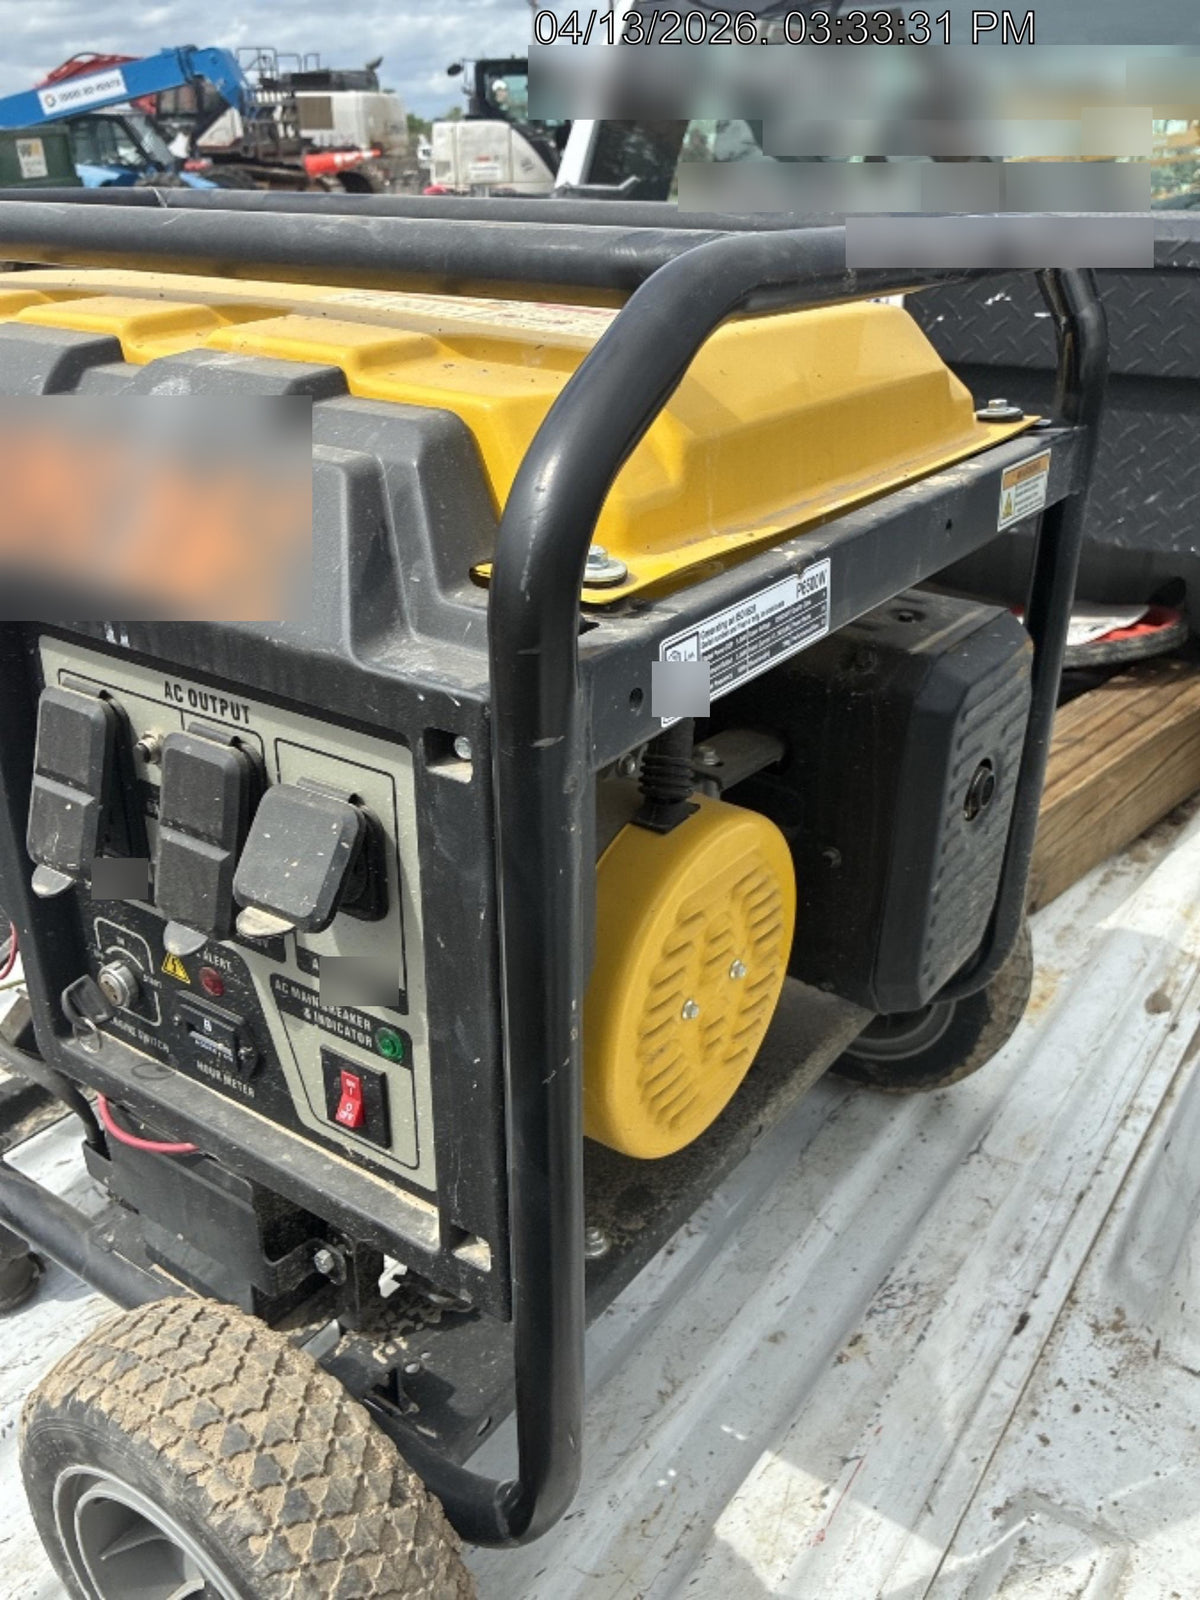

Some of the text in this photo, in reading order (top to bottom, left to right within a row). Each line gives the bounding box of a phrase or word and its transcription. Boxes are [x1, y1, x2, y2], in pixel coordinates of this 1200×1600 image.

[164, 680, 250, 724] AC OUTPUT
[275, 979, 289, 994] AC
[290, 986, 320, 1008] MAIN
[137, 1029, 170, 1053] SWITCH
[313, 1010, 373, 1048] INDICATOR
[223, 1074, 255, 1098] METER
